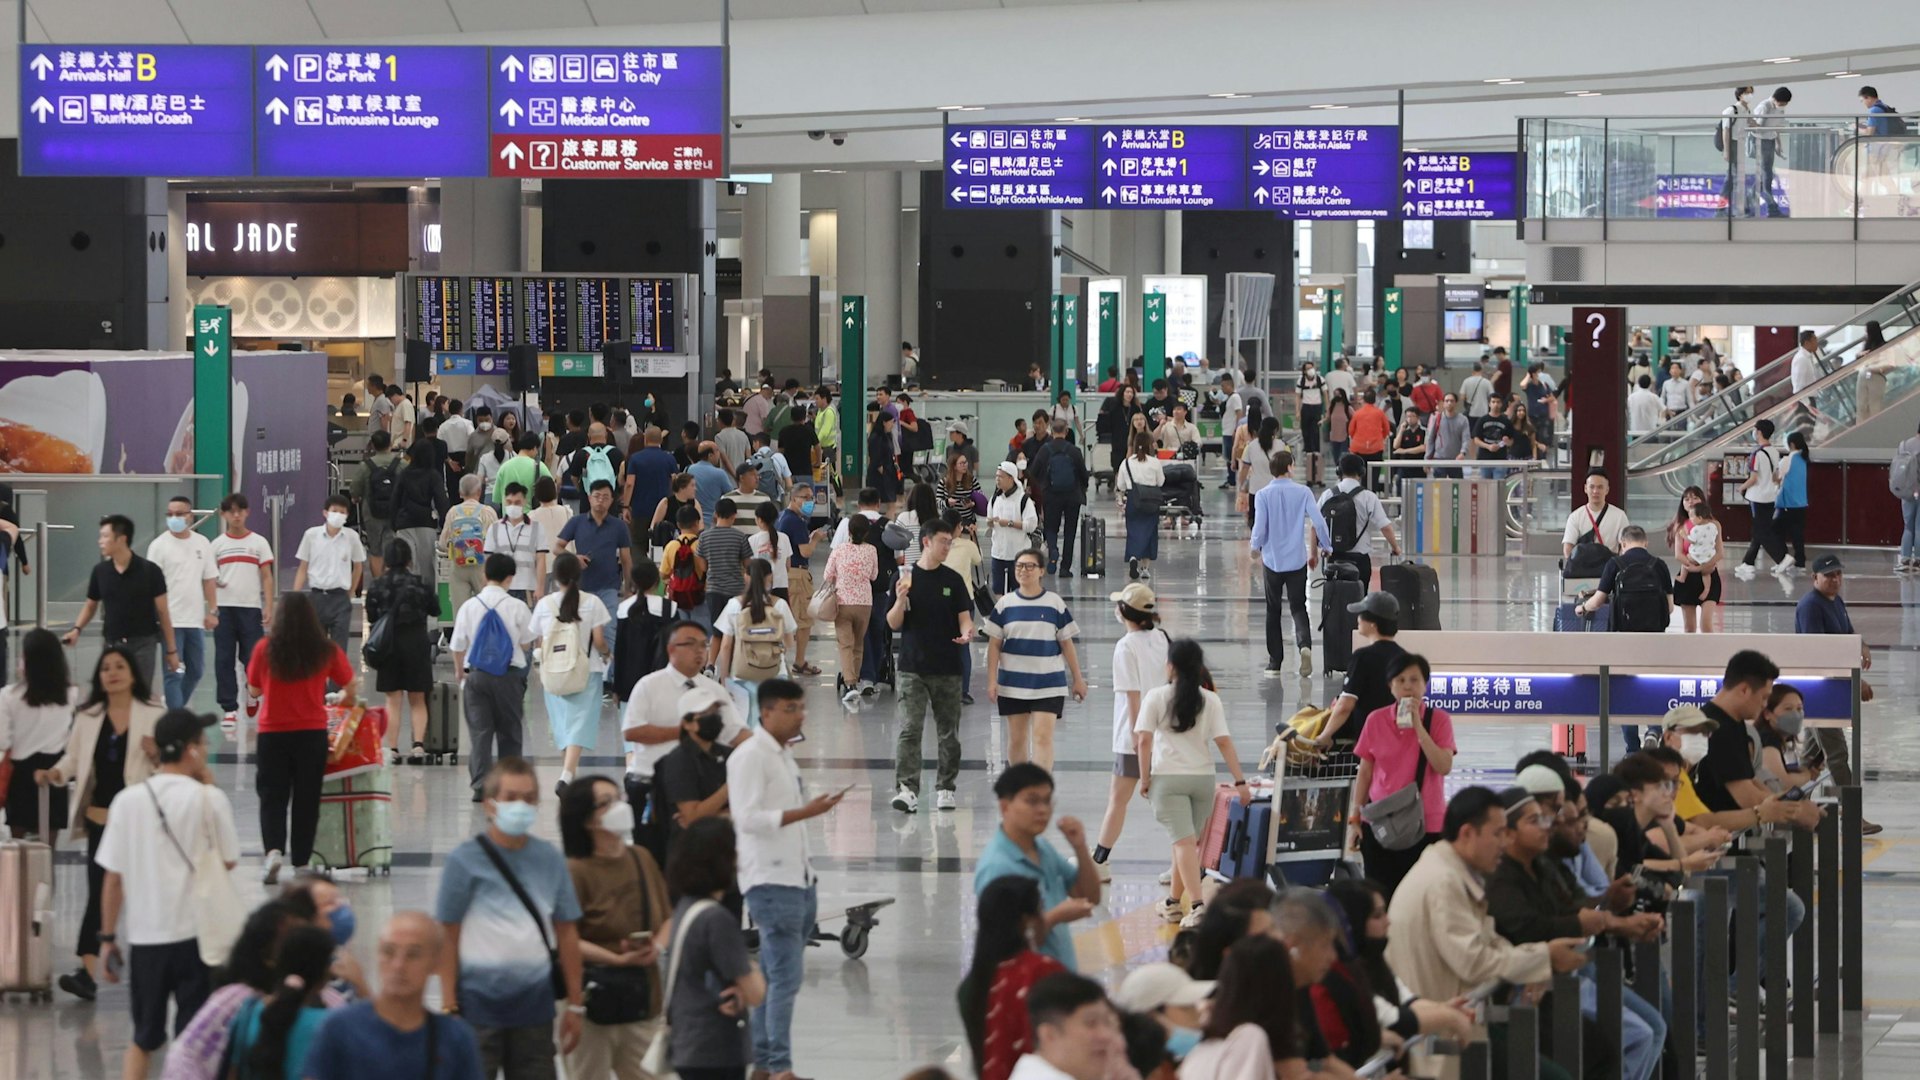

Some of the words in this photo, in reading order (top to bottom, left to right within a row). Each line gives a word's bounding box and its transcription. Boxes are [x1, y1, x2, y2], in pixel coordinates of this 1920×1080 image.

[59, 52, 134, 68] 接機大堂
[326, 52, 381, 70] 停車場
[623, 53, 677, 69] 往市區
[137, 54, 156, 81] B
[385, 55, 396, 81] 1
[59, 69, 106, 82] Arrivals
[108, 69, 131, 82] Hall
[326, 70, 348, 82] Car
[349, 70, 376, 82] Park
[623, 70, 638, 82] To
[639, 70, 661, 85] city
[91, 94, 205, 111] 團隊/酒店巴士
[326, 95, 421, 112] 專車候車室
[561, 96, 635, 113] 醫療中心
[91, 111, 153, 124] Tour/Hotel
[154, 112, 192, 124] Coach
[326, 113, 390, 125] Limousine
[393, 114, 439, 128] Lounge
[561, 113, 608, 126] Medical
[610, 113, 650, 126] Centre
[1031, 129, 1066, 140] 往市區
[1122, 129, 1169, 140] 接機大堂
[1172, 131, 1184, 148] B
[1276, 135, 1288, 146] T1
[1294, 130, 1367, 141] 旅客登記行段
[562, 139, 637, 157] 旅客服務
[1031, 141, 1040, 149] To
[1042, 141, 1056, 150] city
[1121, 141, 1151, 149] Arrivals
[1152, 141, 1167, 149] Hall
[561, 158, 621, 170] Customer
[624, 158, 668, 170] Service
[990, 157, 1063, 167] 團隊/酒店巴士
[1141, 157, 1177, 168] 停車場
[1180, 159, 1186, 175] 1
[1294, 158, 1316, 169] 銀行
[1459, 157, 1470, 171] B
[990, 168, 1029, 176] Tour/Hotel
[1031, 168, 1055, 176] Coach
[1141, 168, 1155, 176] Car
[1156, 168, 1173, 176] Park
[1293, 169, 1313, 177] Bank
[990, 184, 1050, 195] 輕型貨車區
[1141, 184, 1202, 195] 專車候車室
[1293, 186, 1341, 196] 醫療中心
[1467, 179, 1473, 193] 1
[990, 196, 1009, 205] Light
[1065, 196, 1083, 204] Area
[1141, 196, 1181, 204] Limousine
[1184, 196, 1213, 206] Lounge
[1293, 197, 1323, 205] Medical
[1325, 197, 1351, 205] Centre
[233, 222, 298, 252] JADE
[1430, 677, 1531, 695] 團體接待區
[1464, 696, 1510, 711] pick-up
[1514, 699, 1542, 710] area
